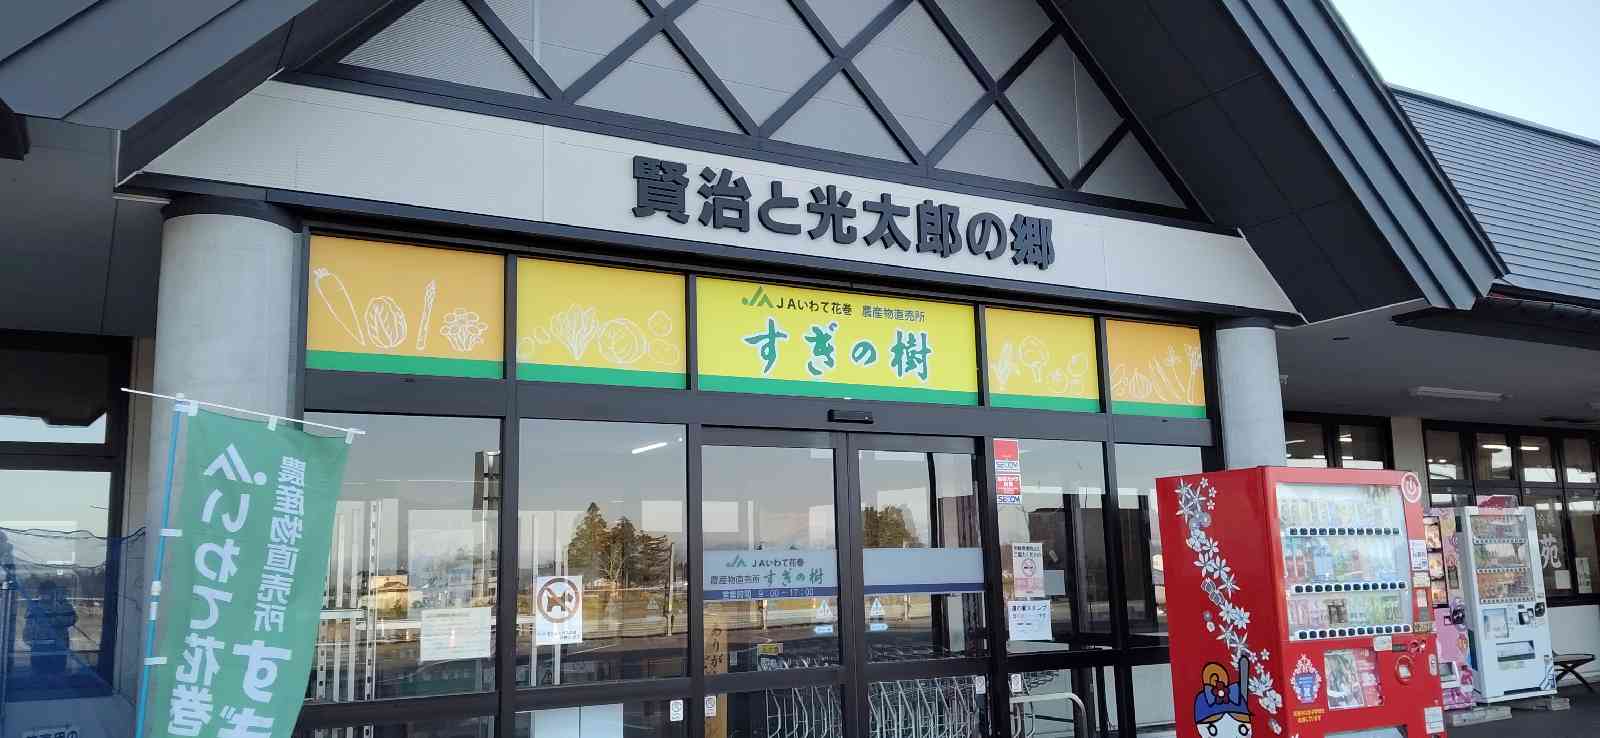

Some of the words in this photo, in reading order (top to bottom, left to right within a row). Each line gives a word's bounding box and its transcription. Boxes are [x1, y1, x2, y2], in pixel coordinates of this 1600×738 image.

[632, 155, 1056, 271] 賢治と光太郎の郷
[776, 298, 852, 316] JAいわて花巻
[862, 304, 925, 323] 農産物直売所
[743, 317, 932, 381] すぎの樹
[998, 495, 1021, 503] SECOM
[763, 567, 825, 587] すぎの樹
